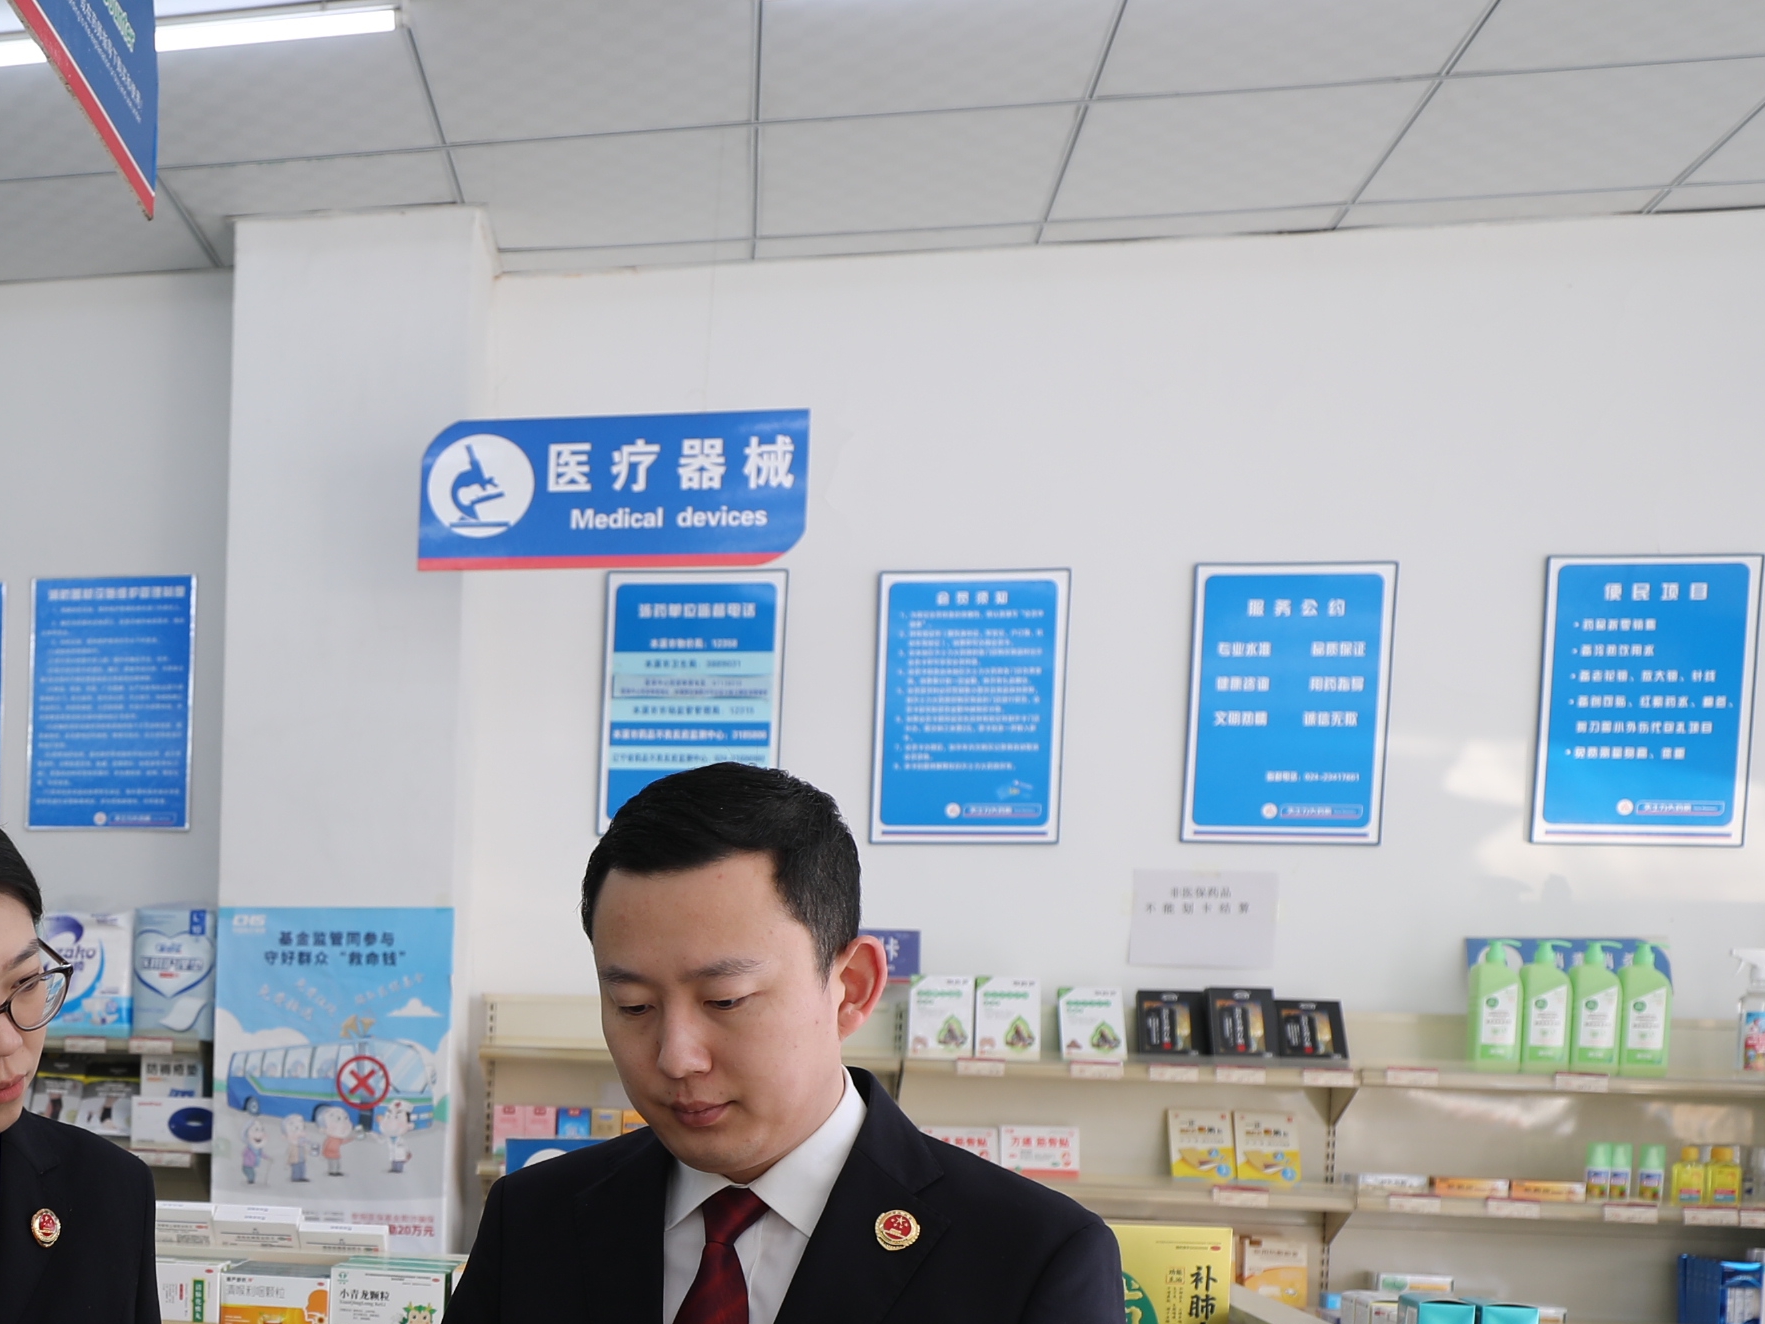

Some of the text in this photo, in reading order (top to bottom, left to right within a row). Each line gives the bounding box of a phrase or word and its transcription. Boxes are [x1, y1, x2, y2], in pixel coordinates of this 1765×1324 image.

[546, 435, 795, 493] 医疗器械
[570, 506, 768, 530] Medical devices
[1170, 886, 1232, 900] 非医保药品
[1146, 902, 1251, 915] 不能划卡结算
[279, 931, 395, 947] 基金监管同参与
[264, 950, 328, 966] 守好群众
[340, 1288, 390, 1302] 小青龙颗粒
